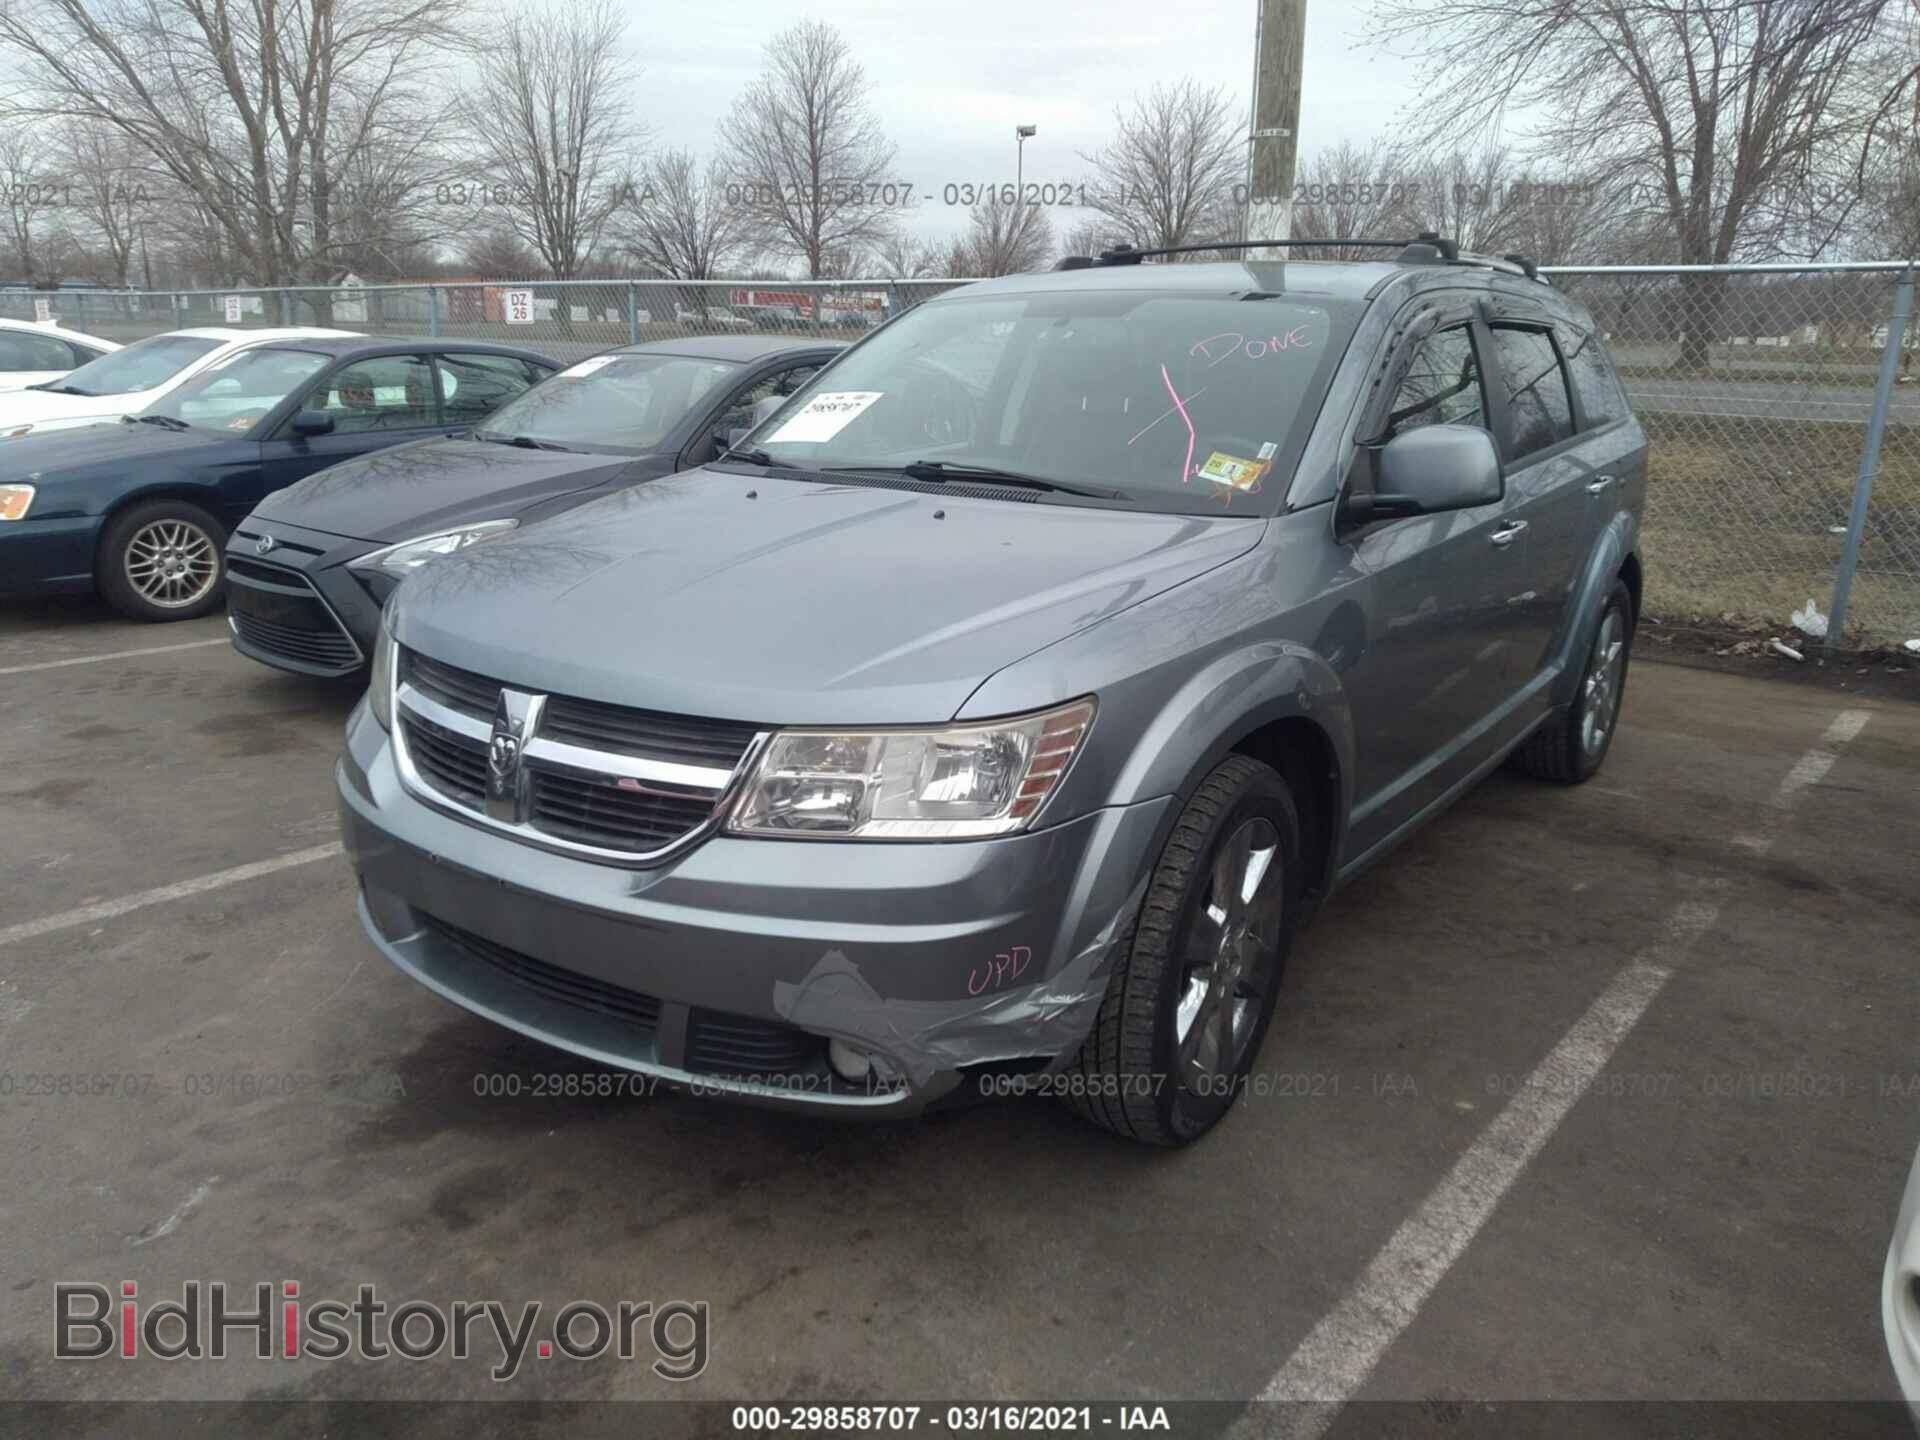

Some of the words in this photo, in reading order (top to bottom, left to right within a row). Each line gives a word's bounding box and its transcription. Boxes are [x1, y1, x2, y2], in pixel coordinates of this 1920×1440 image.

[511, 293, 527, 306] DZ
[512, 306, 527, 320] 26
[1189, 324, 1313, 368] DONE
[968, 945, 1032, 995] UPD
